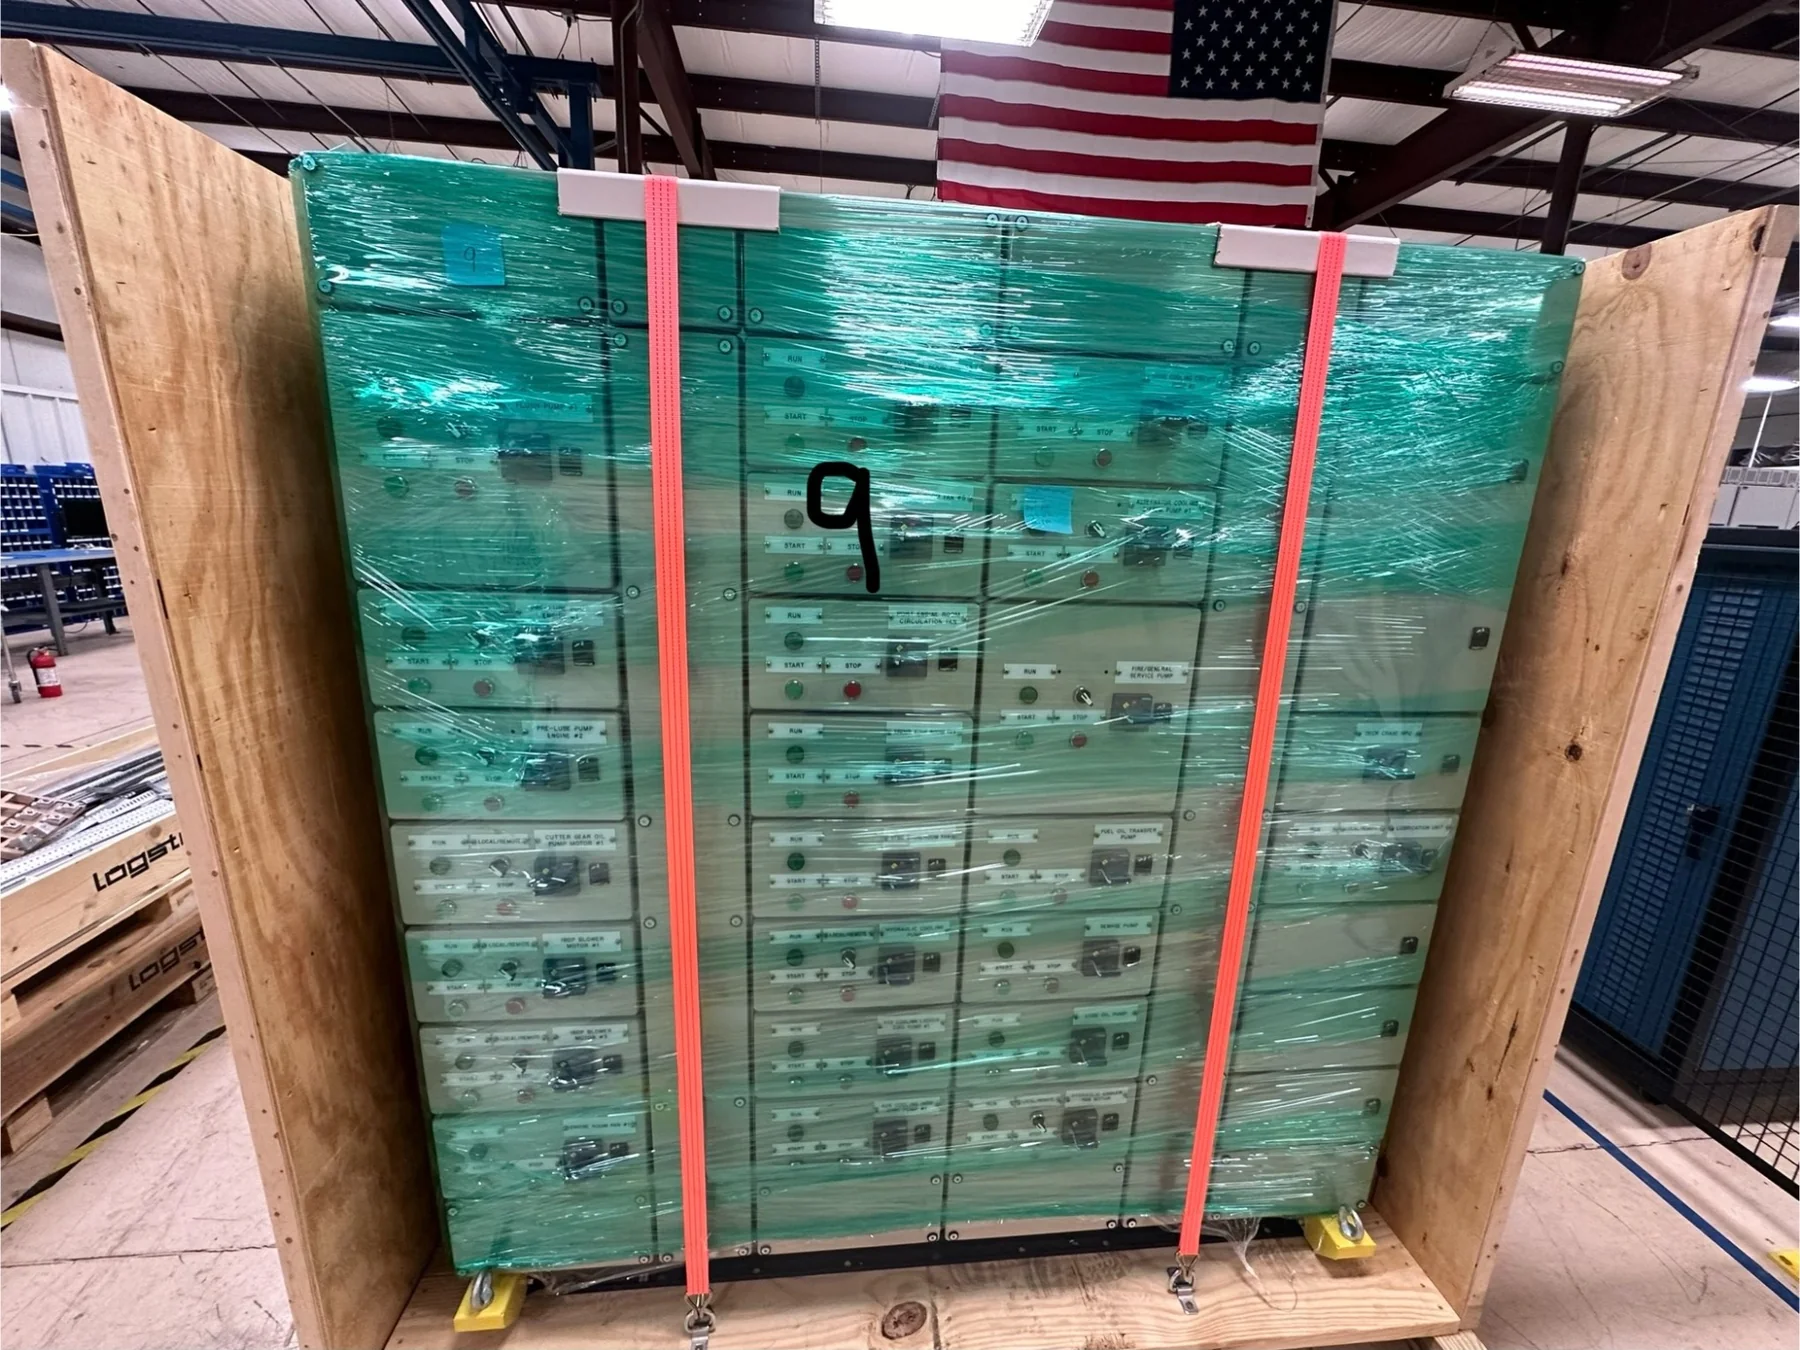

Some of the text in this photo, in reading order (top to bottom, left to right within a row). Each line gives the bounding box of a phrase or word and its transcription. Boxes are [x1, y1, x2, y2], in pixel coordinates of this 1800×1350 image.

[784, 412, 807, 420] START
[1096, 428, 1114, 436] STOP
[456, 456, 474, 464] STOP
[474, 658, 493, 666] STOP
[574, 724, 594, 732] PUMP
